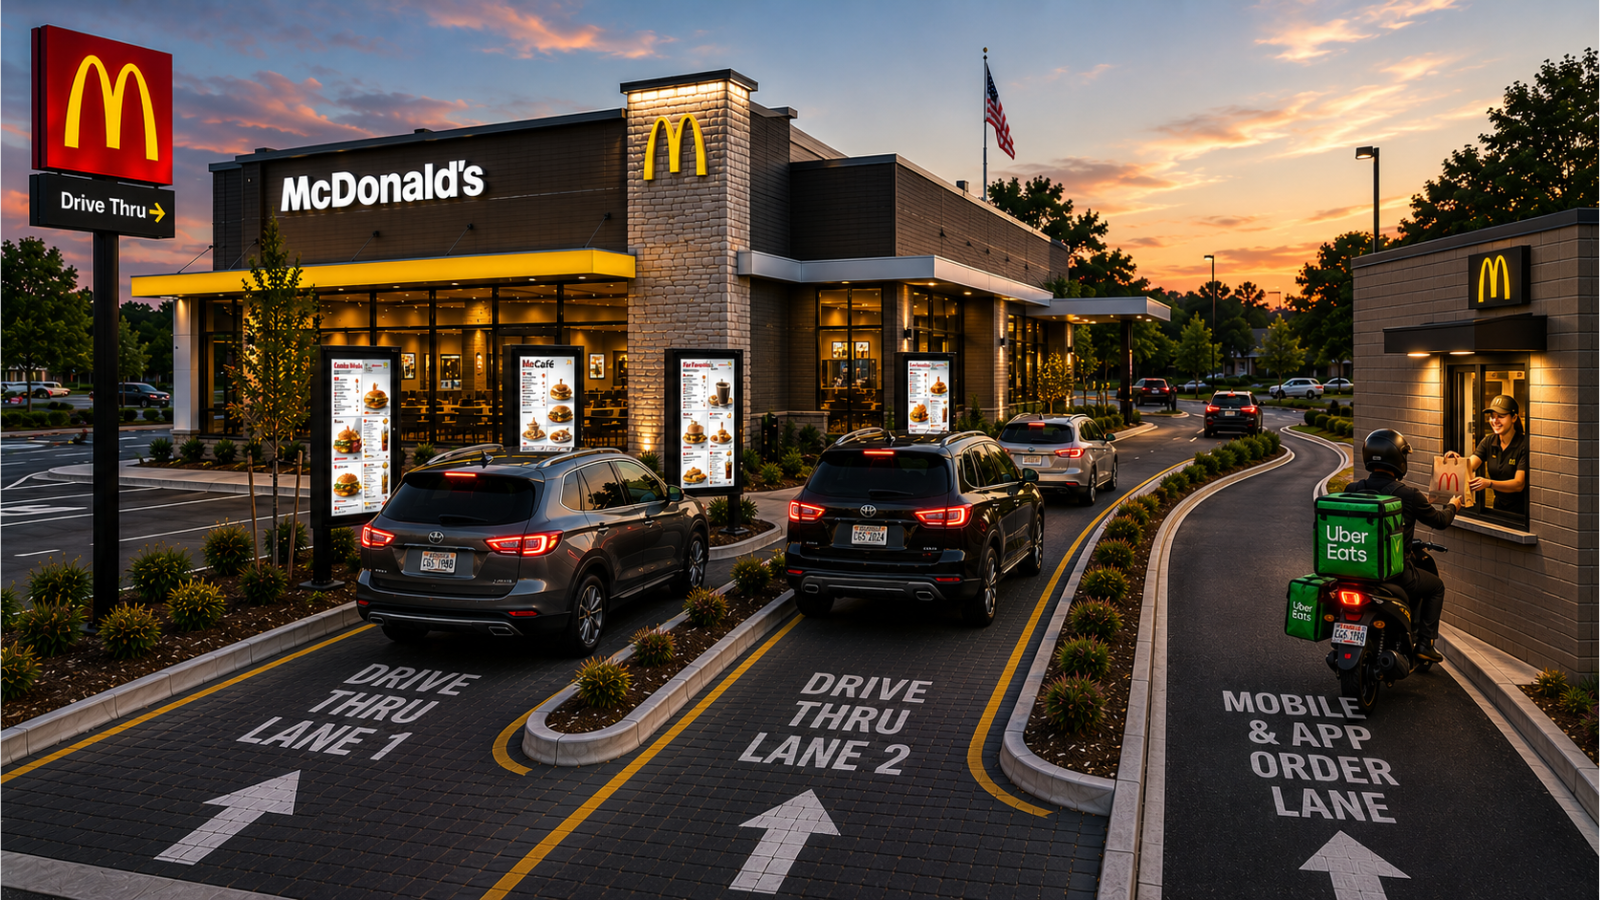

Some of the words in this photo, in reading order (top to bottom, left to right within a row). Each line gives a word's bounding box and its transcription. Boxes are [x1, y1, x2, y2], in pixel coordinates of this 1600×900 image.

[281, 160, 485, 212] McDonald's
[61, 191, 105, 214] Drive
[109, 198, 147, 219] Thru
[1326, 525, 1369, 544] Uber
[1327, 543, 1367, 563] Eats
[1292, 610, 1311, 621] Eats
[1293, 601, 1312, 612] Uber
[343, 663, 482, 696] DRIVE
[800, 672, 933, 703] DRIVE
[308, 689, 439, 724] THRU
[788, 700, 911, 735] THRU
[1222, 690, 1367, 720] MOBILE
[236, 716, 378, 756] LANE
[370, 732, 413, 760] 1
[1248, 719, 1281, 746] &
[1292, 722, 1372, 750] APP
[738, 732, 870, 771] LANE
[874, 743, 911, 775] 2
[1250, 751, 1400, 786] ORDER
[1271, 786, 1397, 824] LANE
